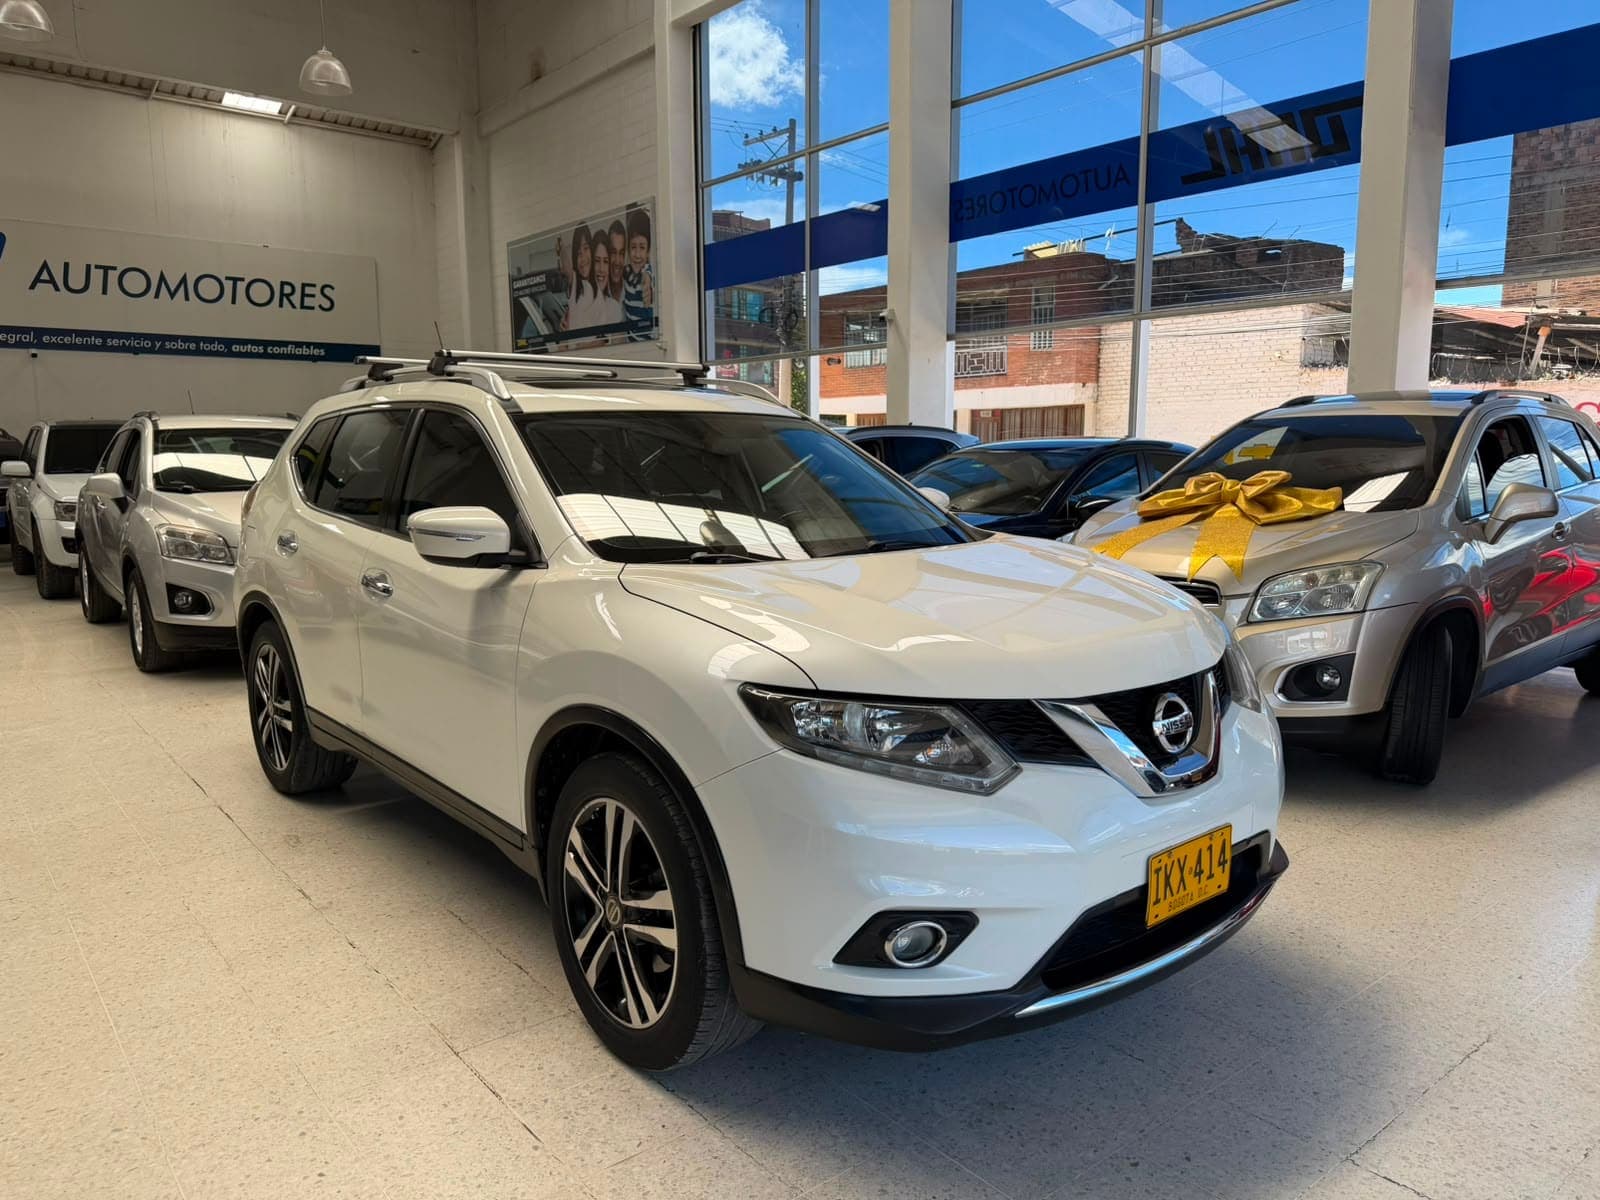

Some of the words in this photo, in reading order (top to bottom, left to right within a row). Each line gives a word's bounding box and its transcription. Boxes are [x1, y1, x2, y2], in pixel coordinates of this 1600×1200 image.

[28, 258, 336, 312] AUTOMOTORES
[42, 333, 103, 346] excelente
[106, 336, 152, 348] servicio
[154, 341, 162, 351] y
[164, 339, 196, 350] sobre
[199, 341, 228, 353] todo,
[231, 343, 265, 354] autos
[267, 344, 326, 357] confiables
